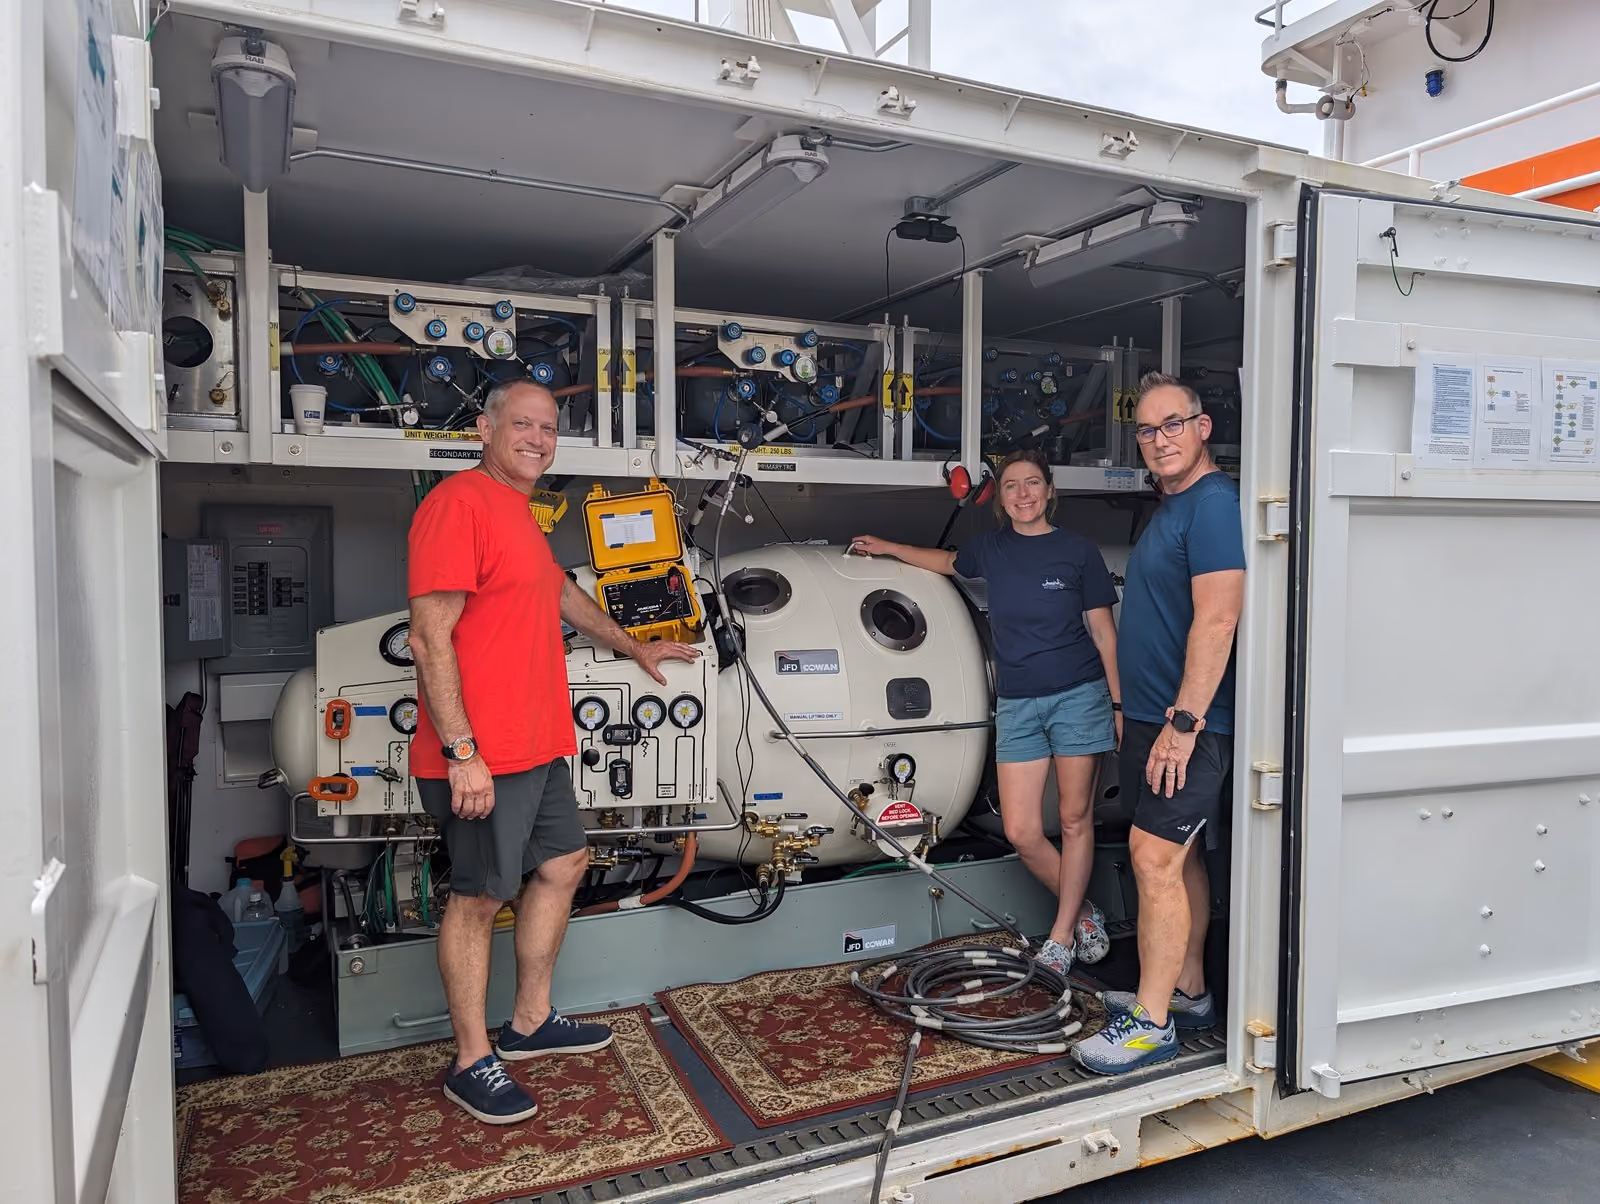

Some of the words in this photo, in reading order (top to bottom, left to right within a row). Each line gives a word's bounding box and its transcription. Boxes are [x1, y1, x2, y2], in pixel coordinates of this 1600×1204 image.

[245, 54, 265, 65] RAB
[404, 430, 422, 438] UNIT
[423, 432, 454, 440] WEIGHT:
[429, 450, 472, 458] SECONDARY
[770, 447, 779, 455] 250
[781, 663, 798, 671] JFD
[802, 663, 838, 671] COWAN
[846, 942, 861, 952] JFD
[864, 937, 895, 949] COWAN
